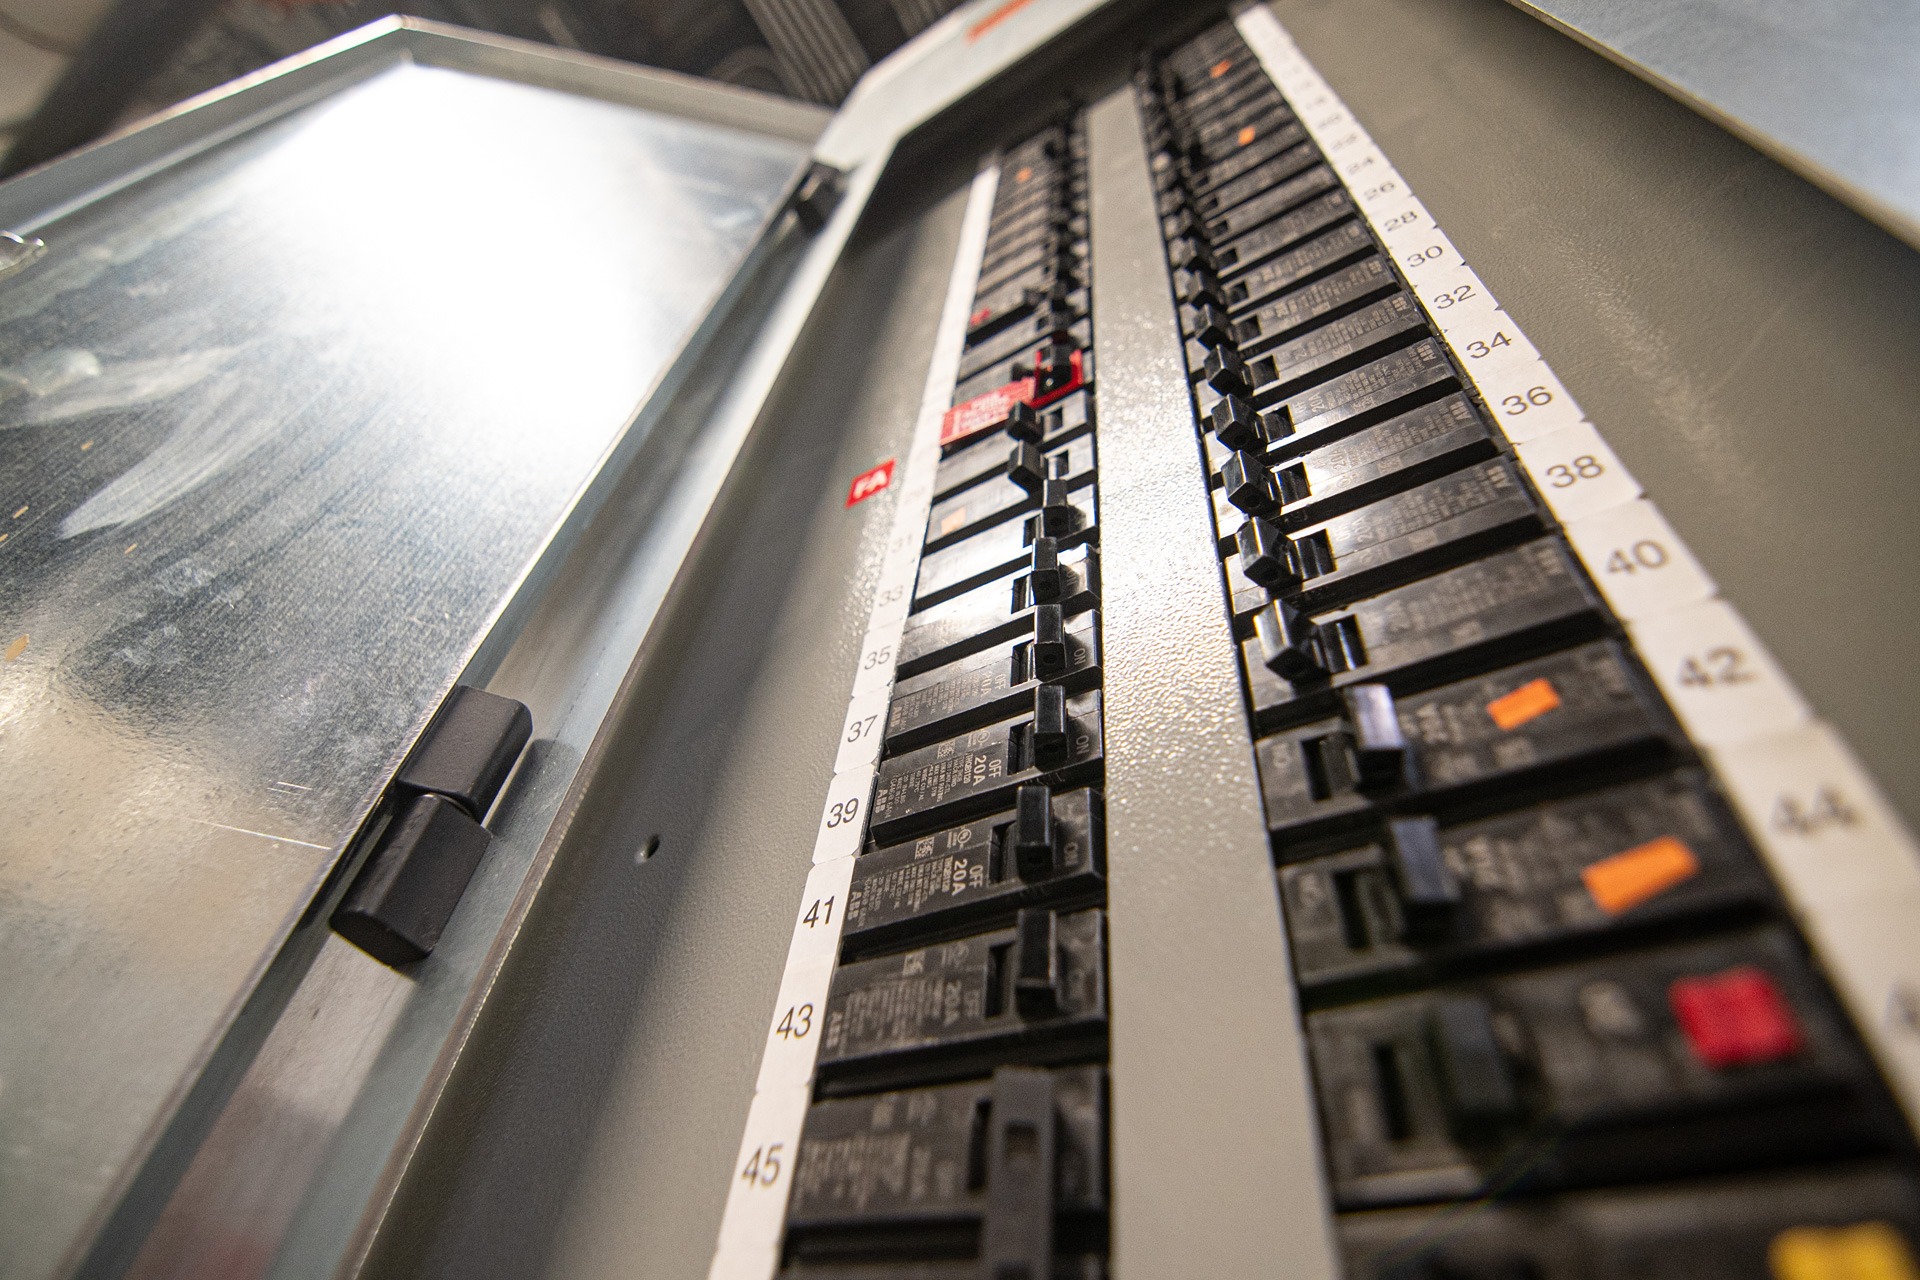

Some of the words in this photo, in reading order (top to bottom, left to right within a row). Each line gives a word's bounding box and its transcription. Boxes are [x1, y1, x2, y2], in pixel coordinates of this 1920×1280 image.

[1364, 181, 1395, 201] 26
[1384, 210, 1418, 232] 28
[1406, 245, 1443, 268] 30
[1433, 285, 1476, 310] 32
[1415, 343, 1437, 362] ABB
[1466, 331, 1512, 359] 34
[1306, 392, 1326, 412] 20A
[1446, 400, 1472, 422] ABB
[1502, 385, 1552, 416] 36
[1325, 448, 1347, 469] 20A
[1545, 455, 1605, 489] 38
[853, 469, 888, 500] FA
[1350, 515, 1374, 543] 20A
[1606, 539, 1670, 577] 40
[879, 585, 903, 607] 33
[864, 646, 891, 670] 35
[1074, 647, 1086, 665] ON
[1678, 647, 1759, 690] 42
[980, 669, 992, 697] 20A
[994, 672, 1005, 692] OFF
[847, 714, 878, 743] 37
[1076, 735, 1089, 754] ON
[972, 753, 987, 786] 20A
[987, 757, 1002, 780] OFF
[827, 797, 859, 828] 39
[874, 786, 888, 814] ABB
[1773, 785, 1862, 836] 44
[951, 857, 967, 896] 20A
[968, 863, 983, 890] OFF
[803, 895, 835, 929] 41
[847, 888, 862, 920] ABB
[776, 1003, 813, 1041] 43
[742, 1142, 783, 1187] 45
